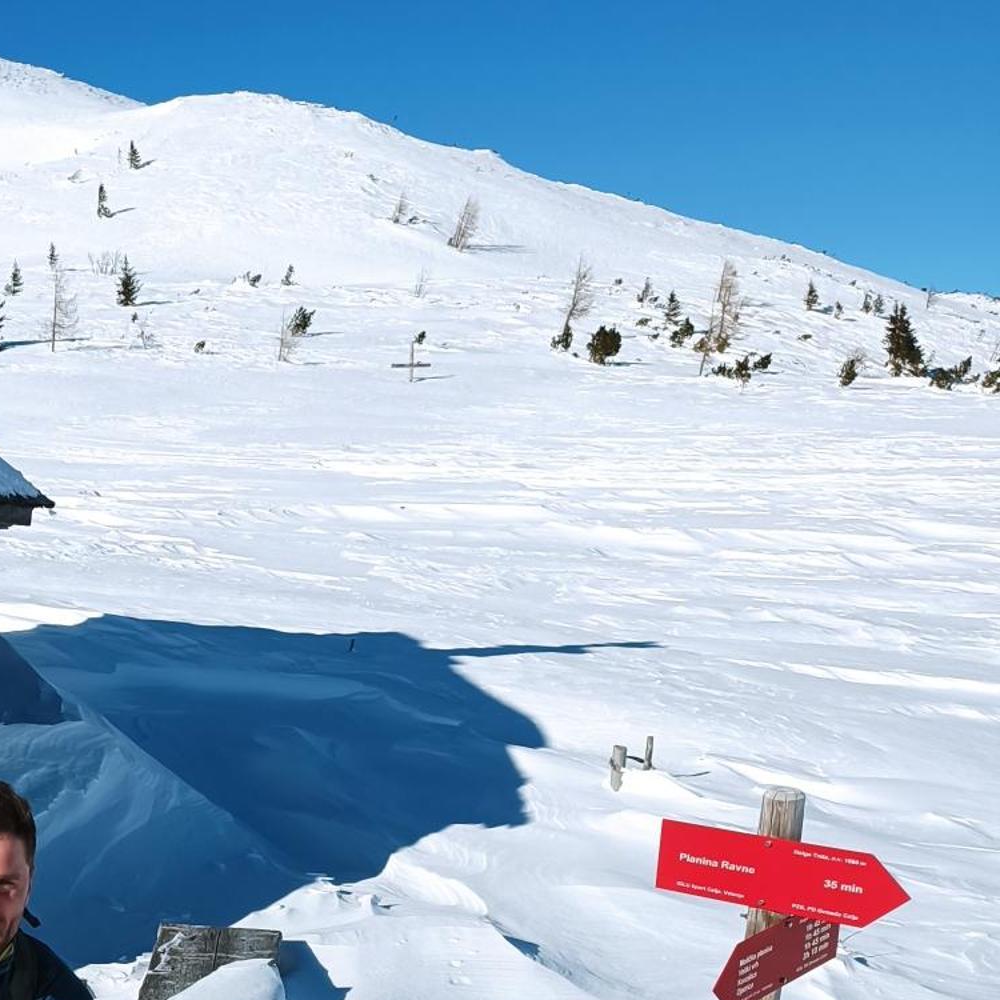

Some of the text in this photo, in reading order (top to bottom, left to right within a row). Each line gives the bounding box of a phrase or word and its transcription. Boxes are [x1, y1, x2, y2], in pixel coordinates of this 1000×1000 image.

[679, 852, 719, 868] Planina
[823, 879, 864, 894] 35 min
